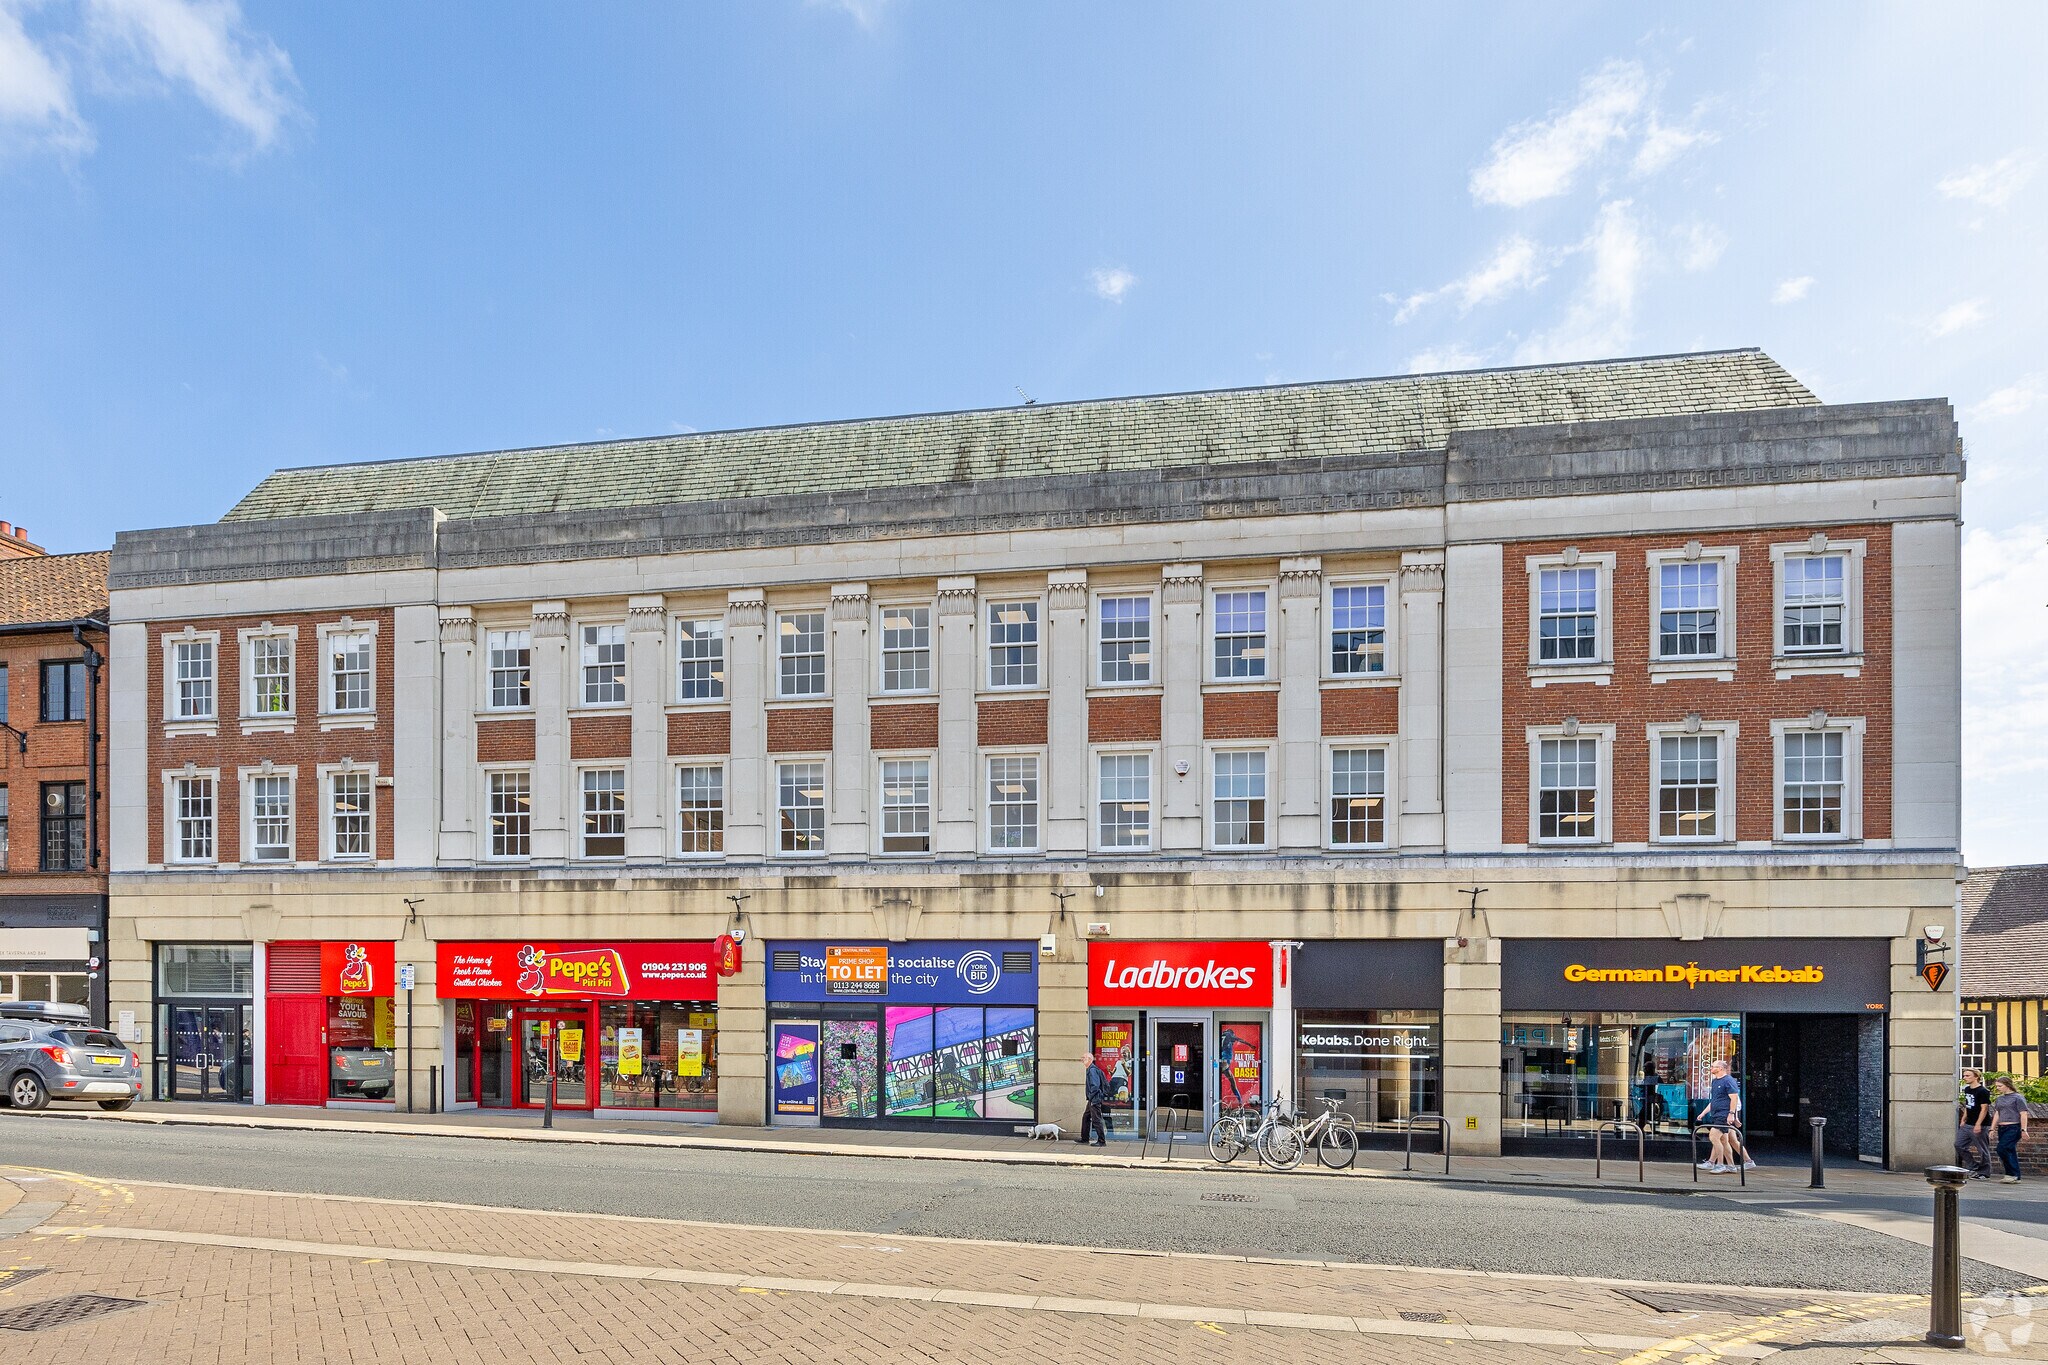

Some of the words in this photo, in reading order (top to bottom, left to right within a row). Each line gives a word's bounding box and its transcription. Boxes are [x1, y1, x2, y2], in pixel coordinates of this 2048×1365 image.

[454, 956, 466, 964] The
[466, 956, 484, 964] Home
[484, 956, 492, 967] of
[898, 957, 955, 968] socialise
[453, 967, 472, 976] Fresh
[472, 967, 492, 976] Flame
[550, 956, 612, 983] Pepe's
[642, 963, 670, 971] 01904
[672, 963, 688, 971] 231
[688, 963, 706, 971] 906
[642, 972, 707, 980] www.pepes.co.uk
[830, 966, 852, 979] TO
[856, 966, 884, 979] LET
[971, 972, 988, 980] BID
[1104, 960, 1256, 989] Ladbrokes
[1564, 964, 1664, 983] German
[1740, 965, 1824, 983] Kebab
[344, 978, 367, 989] Pepe's
[454, 978, 476, 986] Grilled
[477, 978, 502, 986] Chicken
[582, 979, 596, 987] Piri
[598, 979, 612, 987] Piri
[800, 972, 812, 984] in
[815, 972, 827, 984] th
[891, 973, 912, 984] the
[916, 973, 939, 987] city
[340, 1002, 366, 1011] YOU'LL
[338, 1010, 367, 1018] SAVOUR
[1102, 1032, 1128, 1040] HISTORY
[1301, 1034, 1352, 1046] Kebabs.
[1354, 1035, 1390, 1046] Done
[1393, 1035, 1430, 1049] Right.
[1234, 1068, 1258, 1078] BASEL
[1467, 1118, 1476, 1128] H
